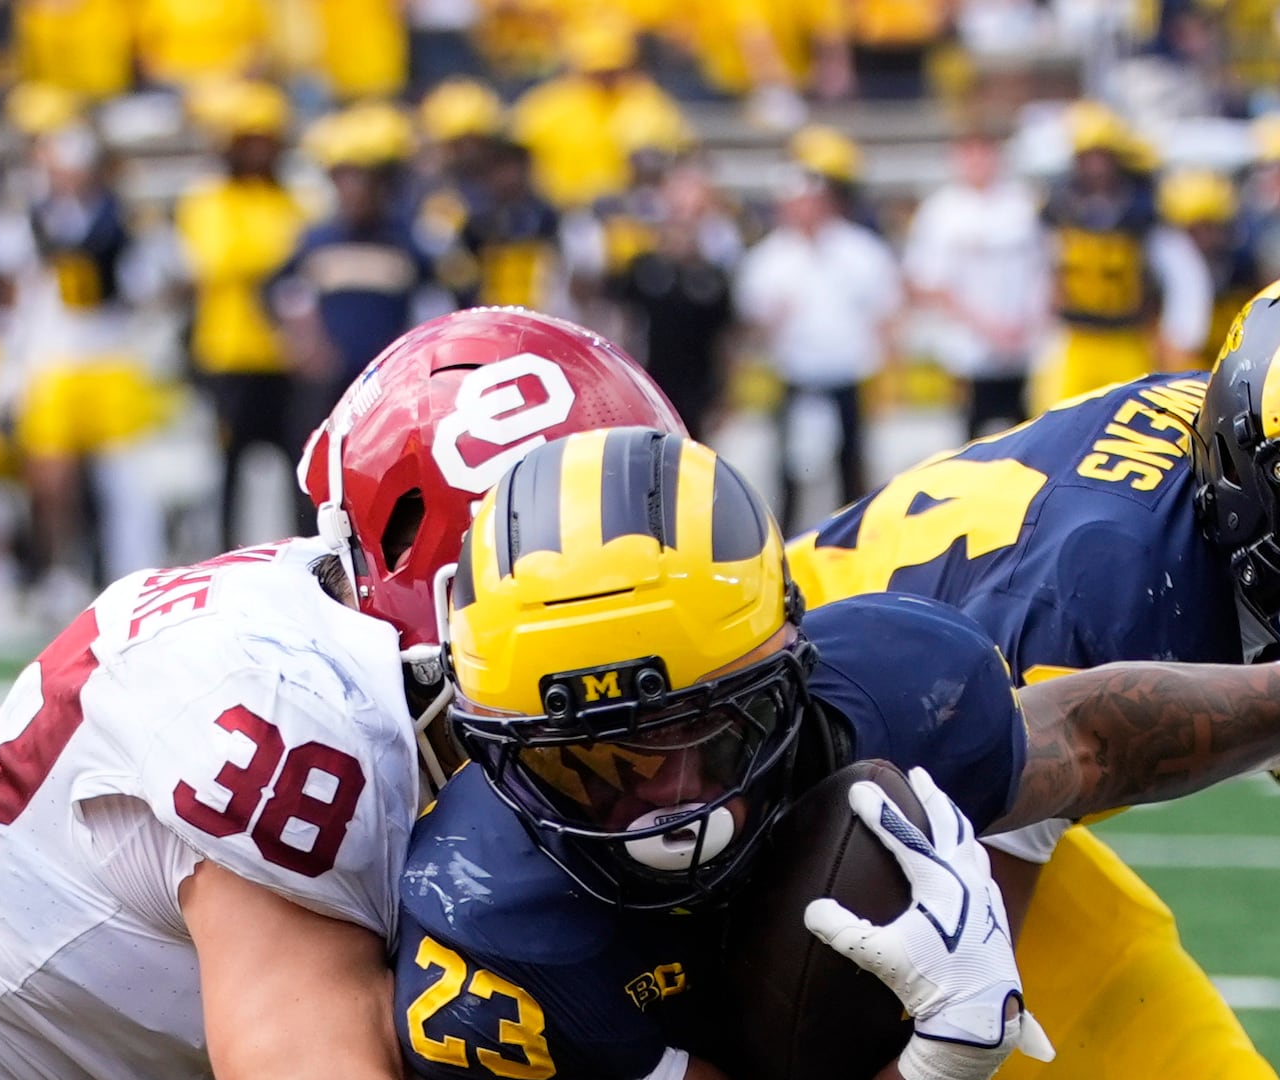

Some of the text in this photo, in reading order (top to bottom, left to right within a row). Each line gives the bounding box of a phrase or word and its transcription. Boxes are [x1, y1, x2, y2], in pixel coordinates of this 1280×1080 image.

[1076, 379, 1209, 491] OWENS
[582, 671, 622, 702] M
[173, 703, 366, 878] 38
